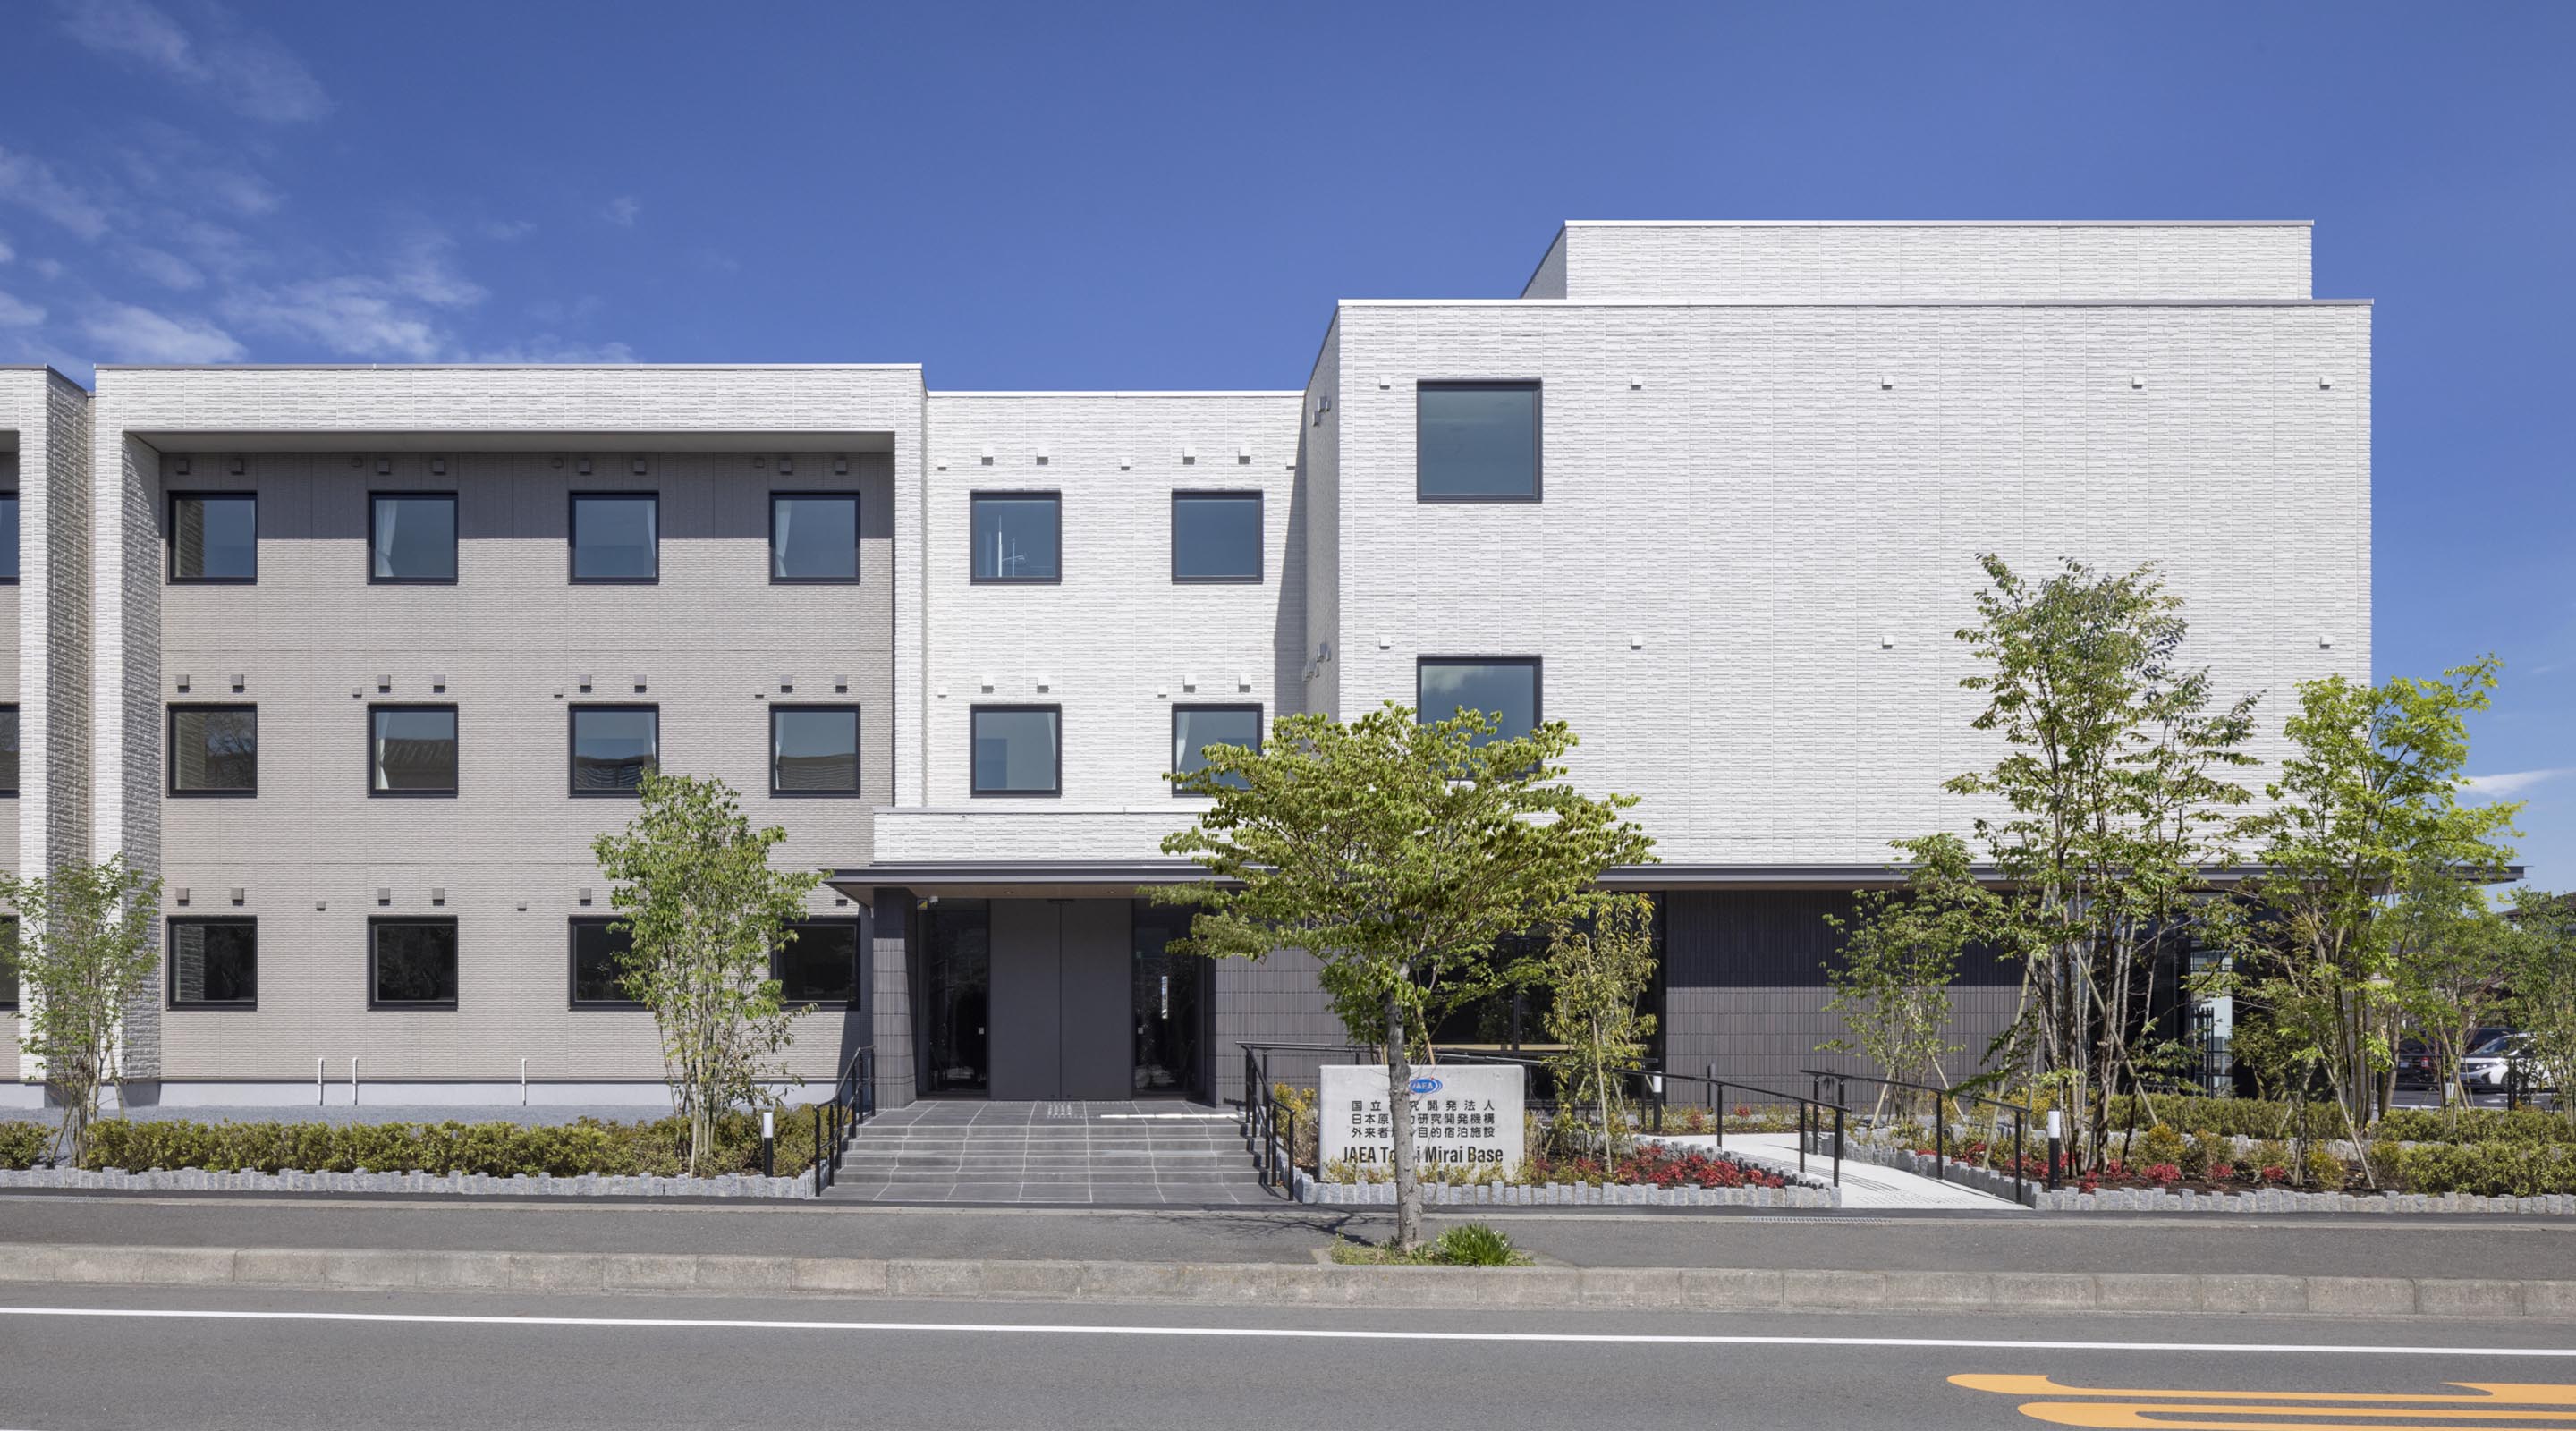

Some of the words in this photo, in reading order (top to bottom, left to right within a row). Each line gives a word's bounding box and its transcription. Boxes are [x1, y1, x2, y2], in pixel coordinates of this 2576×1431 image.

[1412, 1081, 1434, 1089] JAEA
[1352, 1099, 1495, 1111] 国立究開発法人
[1352, 1113, 1495, 1124] 日本原研究開発機構
[1352, 1127, 1495, 1138] 外来者目的宿泊施設
[1343, 1146, 1377, 1163] JAEA
[1380, 1146, 1420, 1163] Toi
[1425, 1146, 1463, 1163] Mirai
[1468, 1146, 1504, 1163] Base
